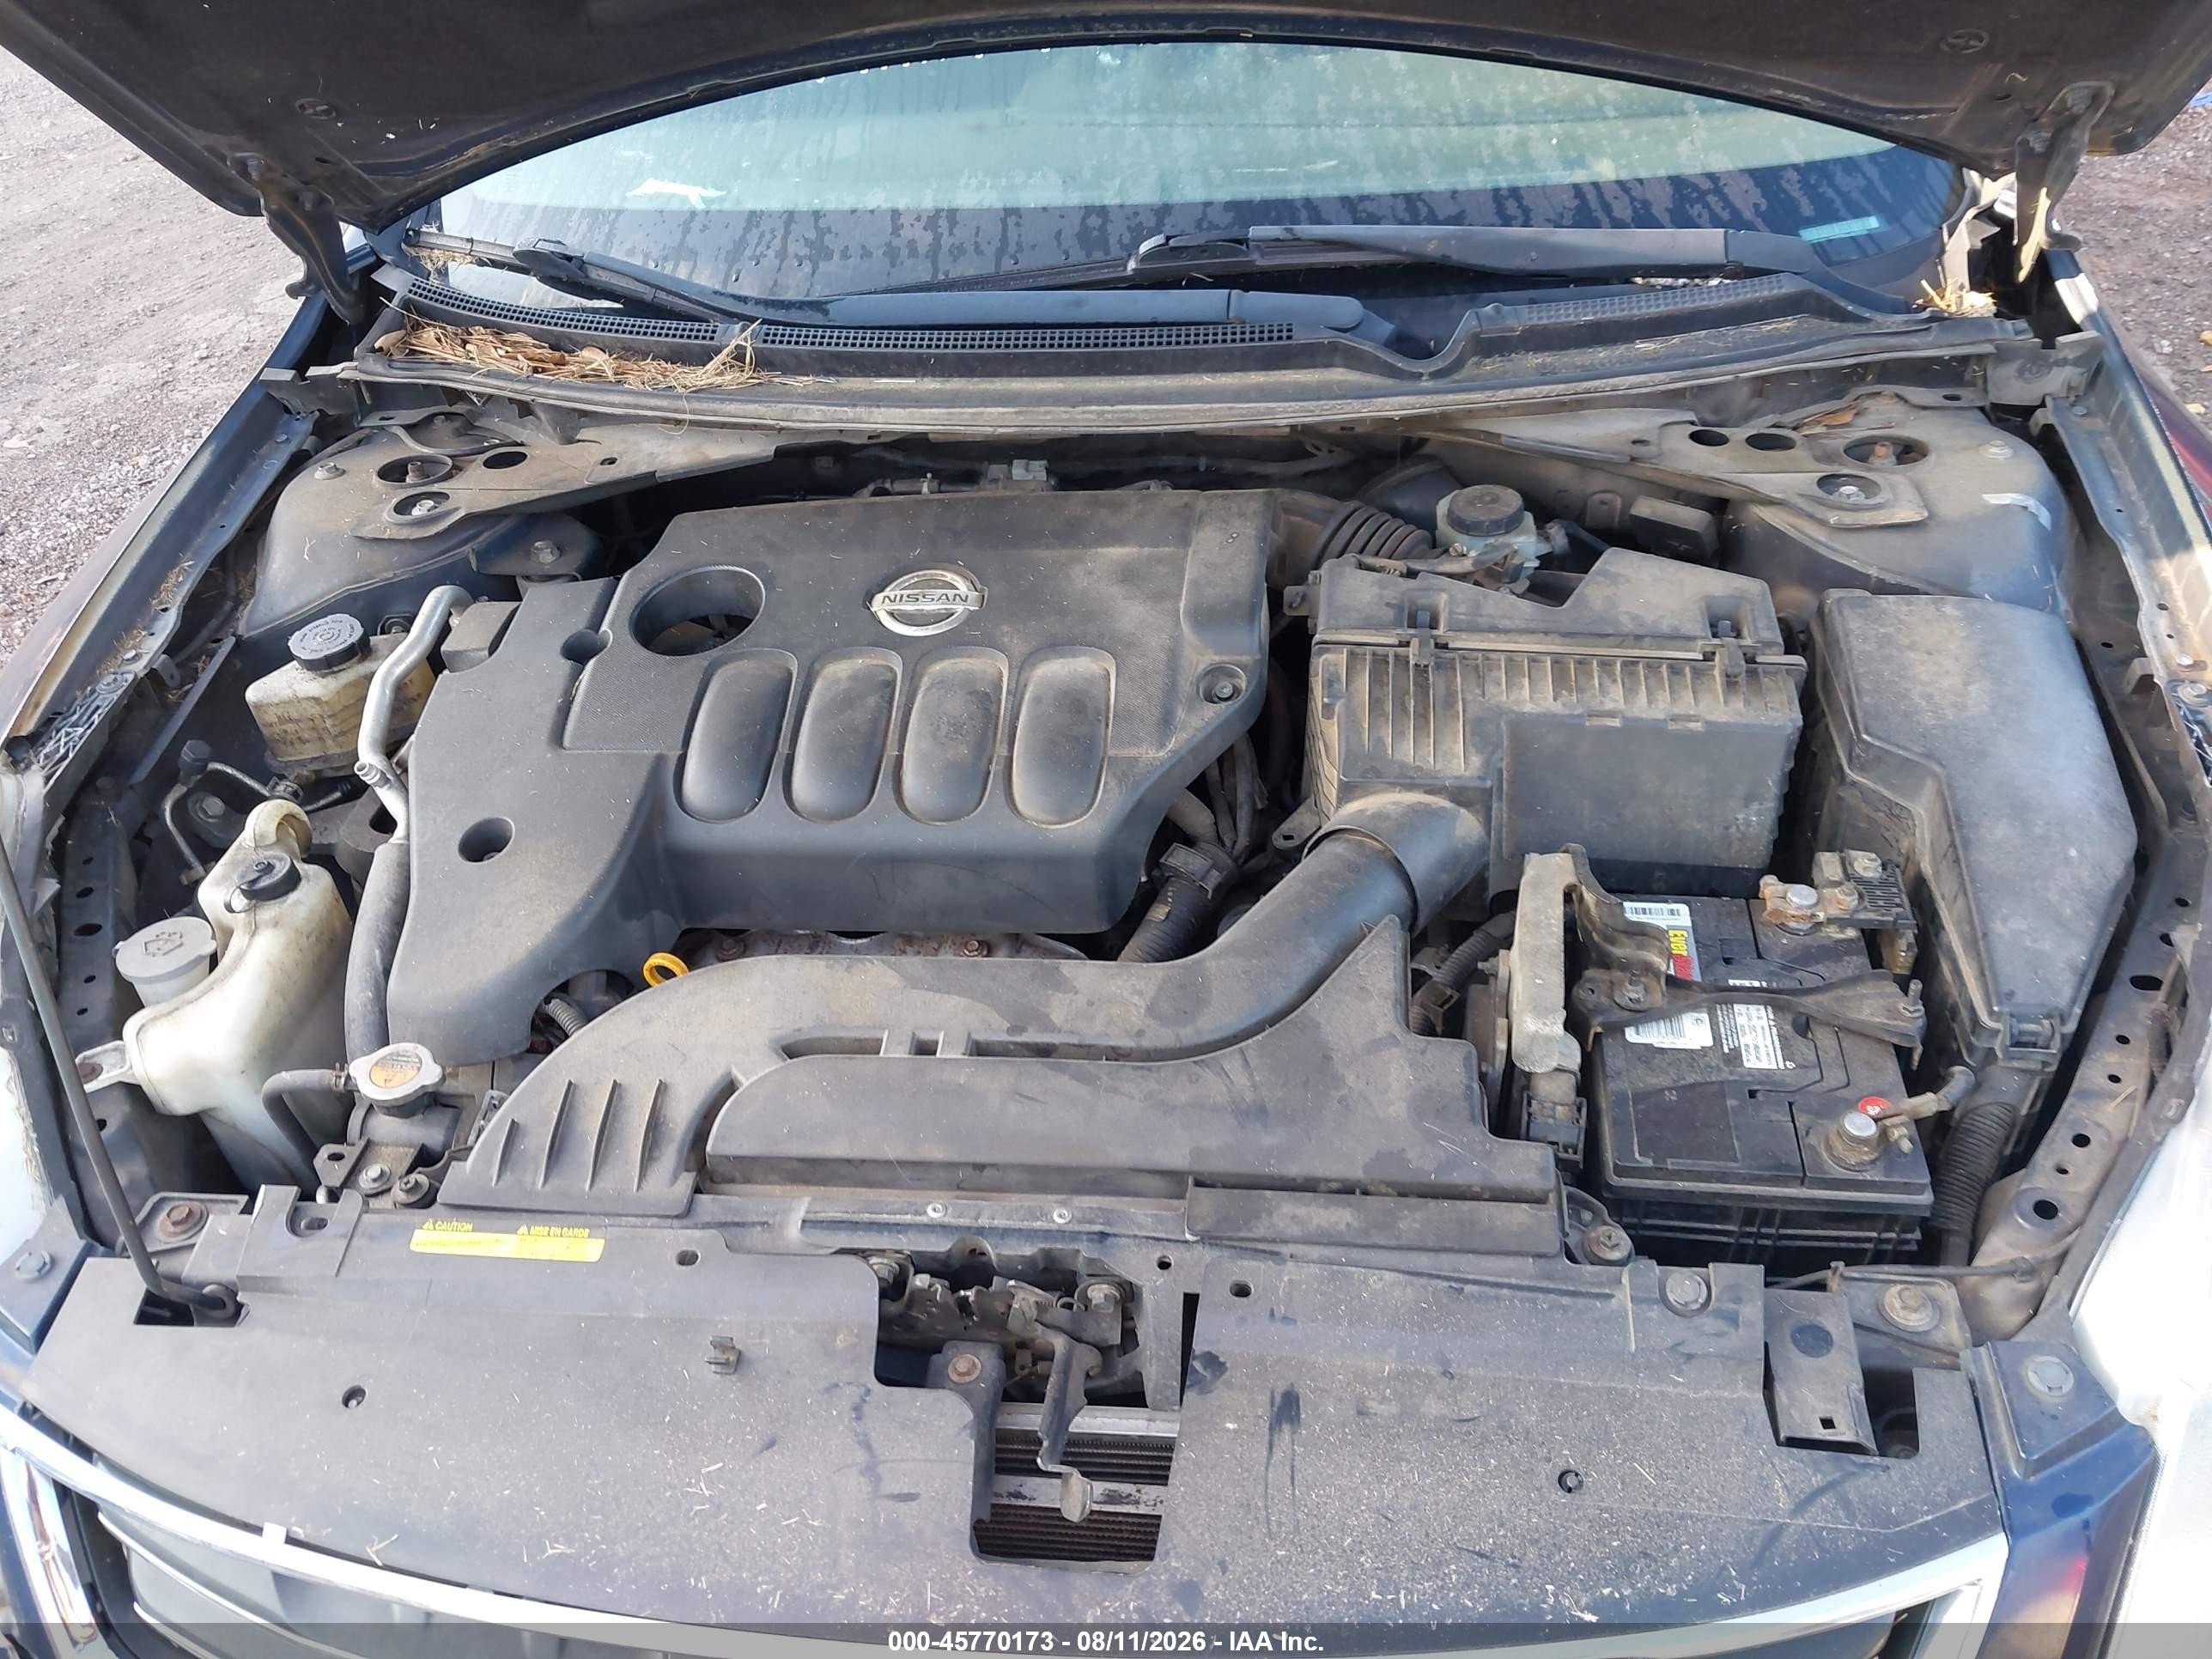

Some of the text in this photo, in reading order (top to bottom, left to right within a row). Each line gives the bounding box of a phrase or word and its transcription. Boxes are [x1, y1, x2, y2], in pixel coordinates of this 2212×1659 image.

[881, 593, 969, 605] NISSAN
[434, 1220, 473, 1233] CAUTION
[529, 1225, 591, 1238] MISE EN GARDE
